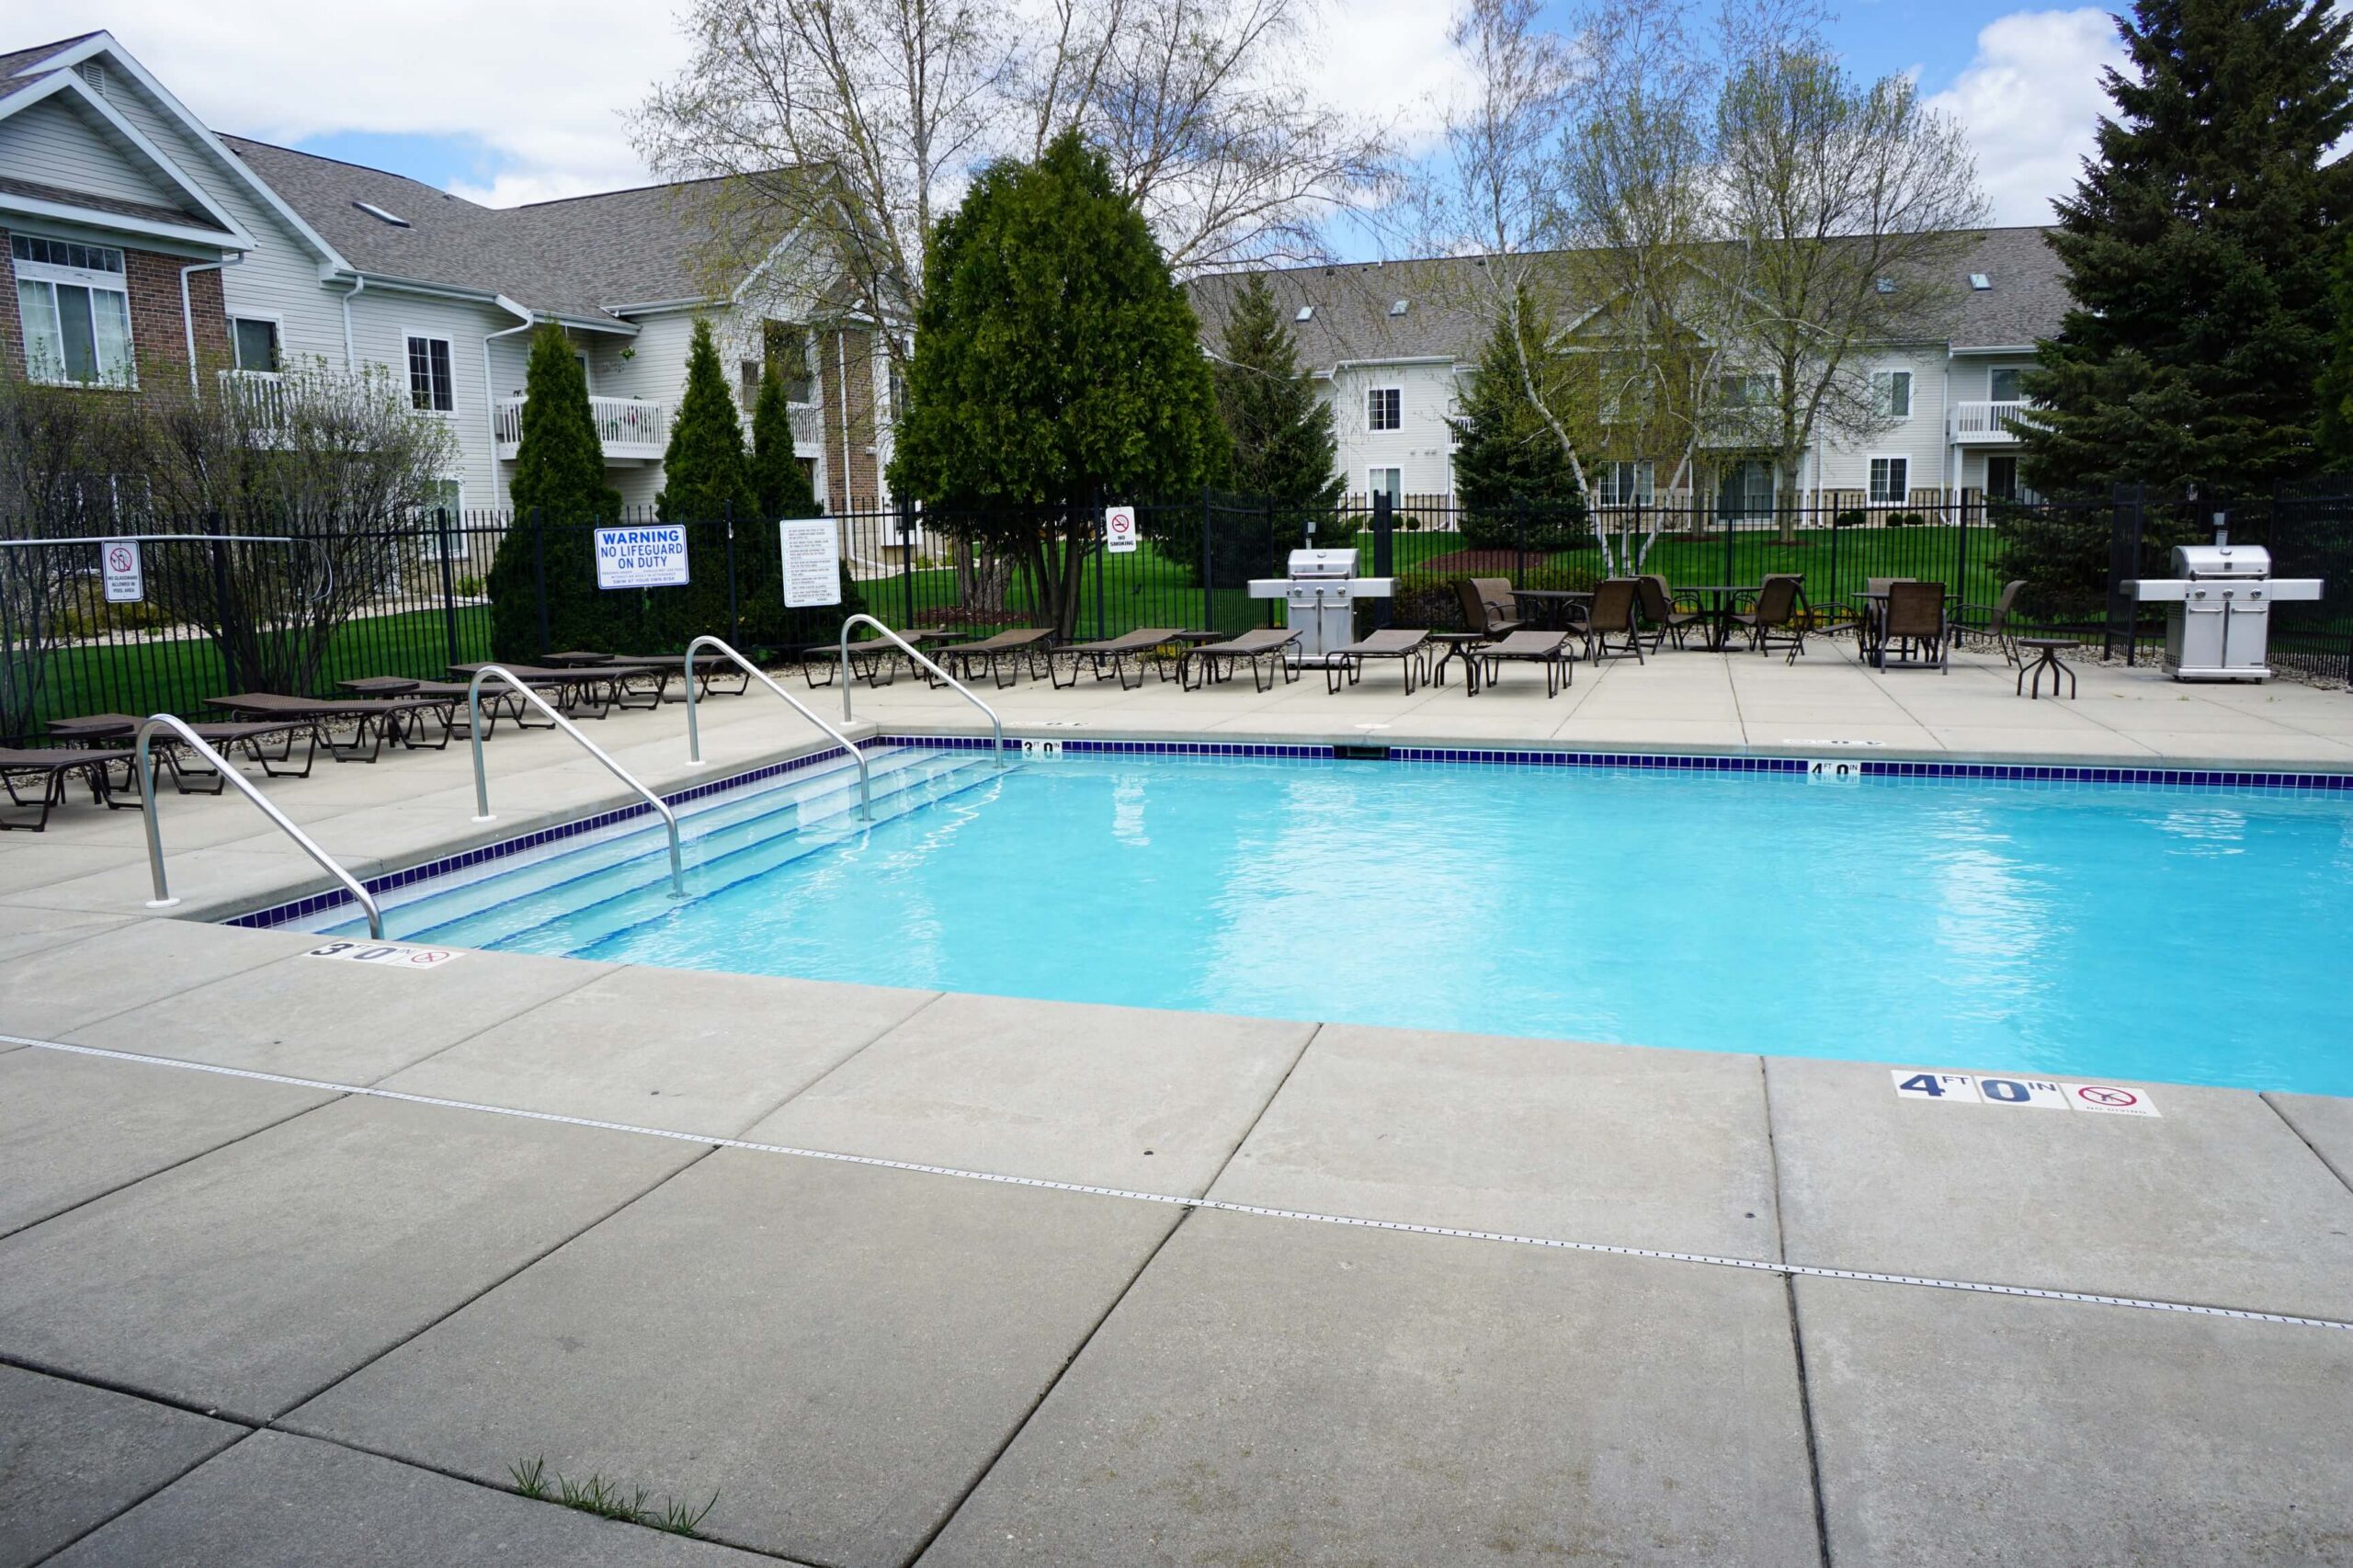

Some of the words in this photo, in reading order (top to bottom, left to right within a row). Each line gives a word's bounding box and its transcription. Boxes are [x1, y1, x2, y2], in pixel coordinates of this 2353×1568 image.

[603, 530, 679, 544] WARNING
[600, 546, 617, 558] NO
[620, 543, 683, 557] LIFEGUARD
[618, 558, 634, 569] ON
[638, 556, 667, 568] DUTY
